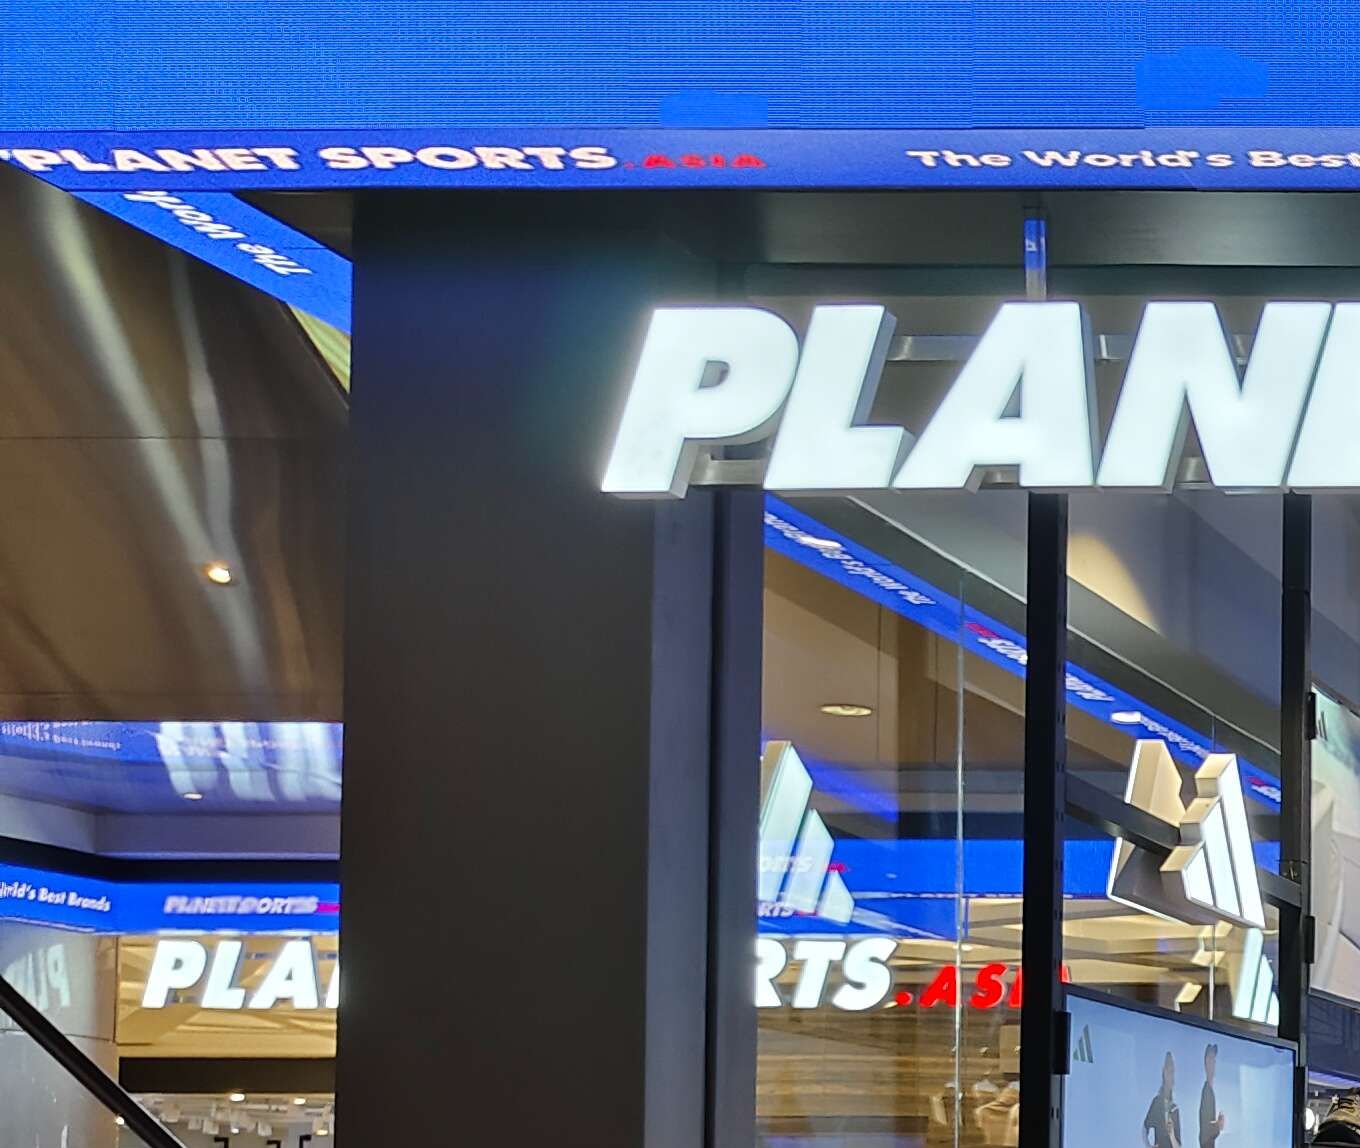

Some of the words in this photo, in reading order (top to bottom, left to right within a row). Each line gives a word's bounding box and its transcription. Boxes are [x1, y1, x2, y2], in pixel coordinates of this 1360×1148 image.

[11, 147, 299, 172] PLANET
[905, 150, 1011, 167] The
[1023, 150, 1233, 168] World's
[141, 940, 339, 1009] PLA
